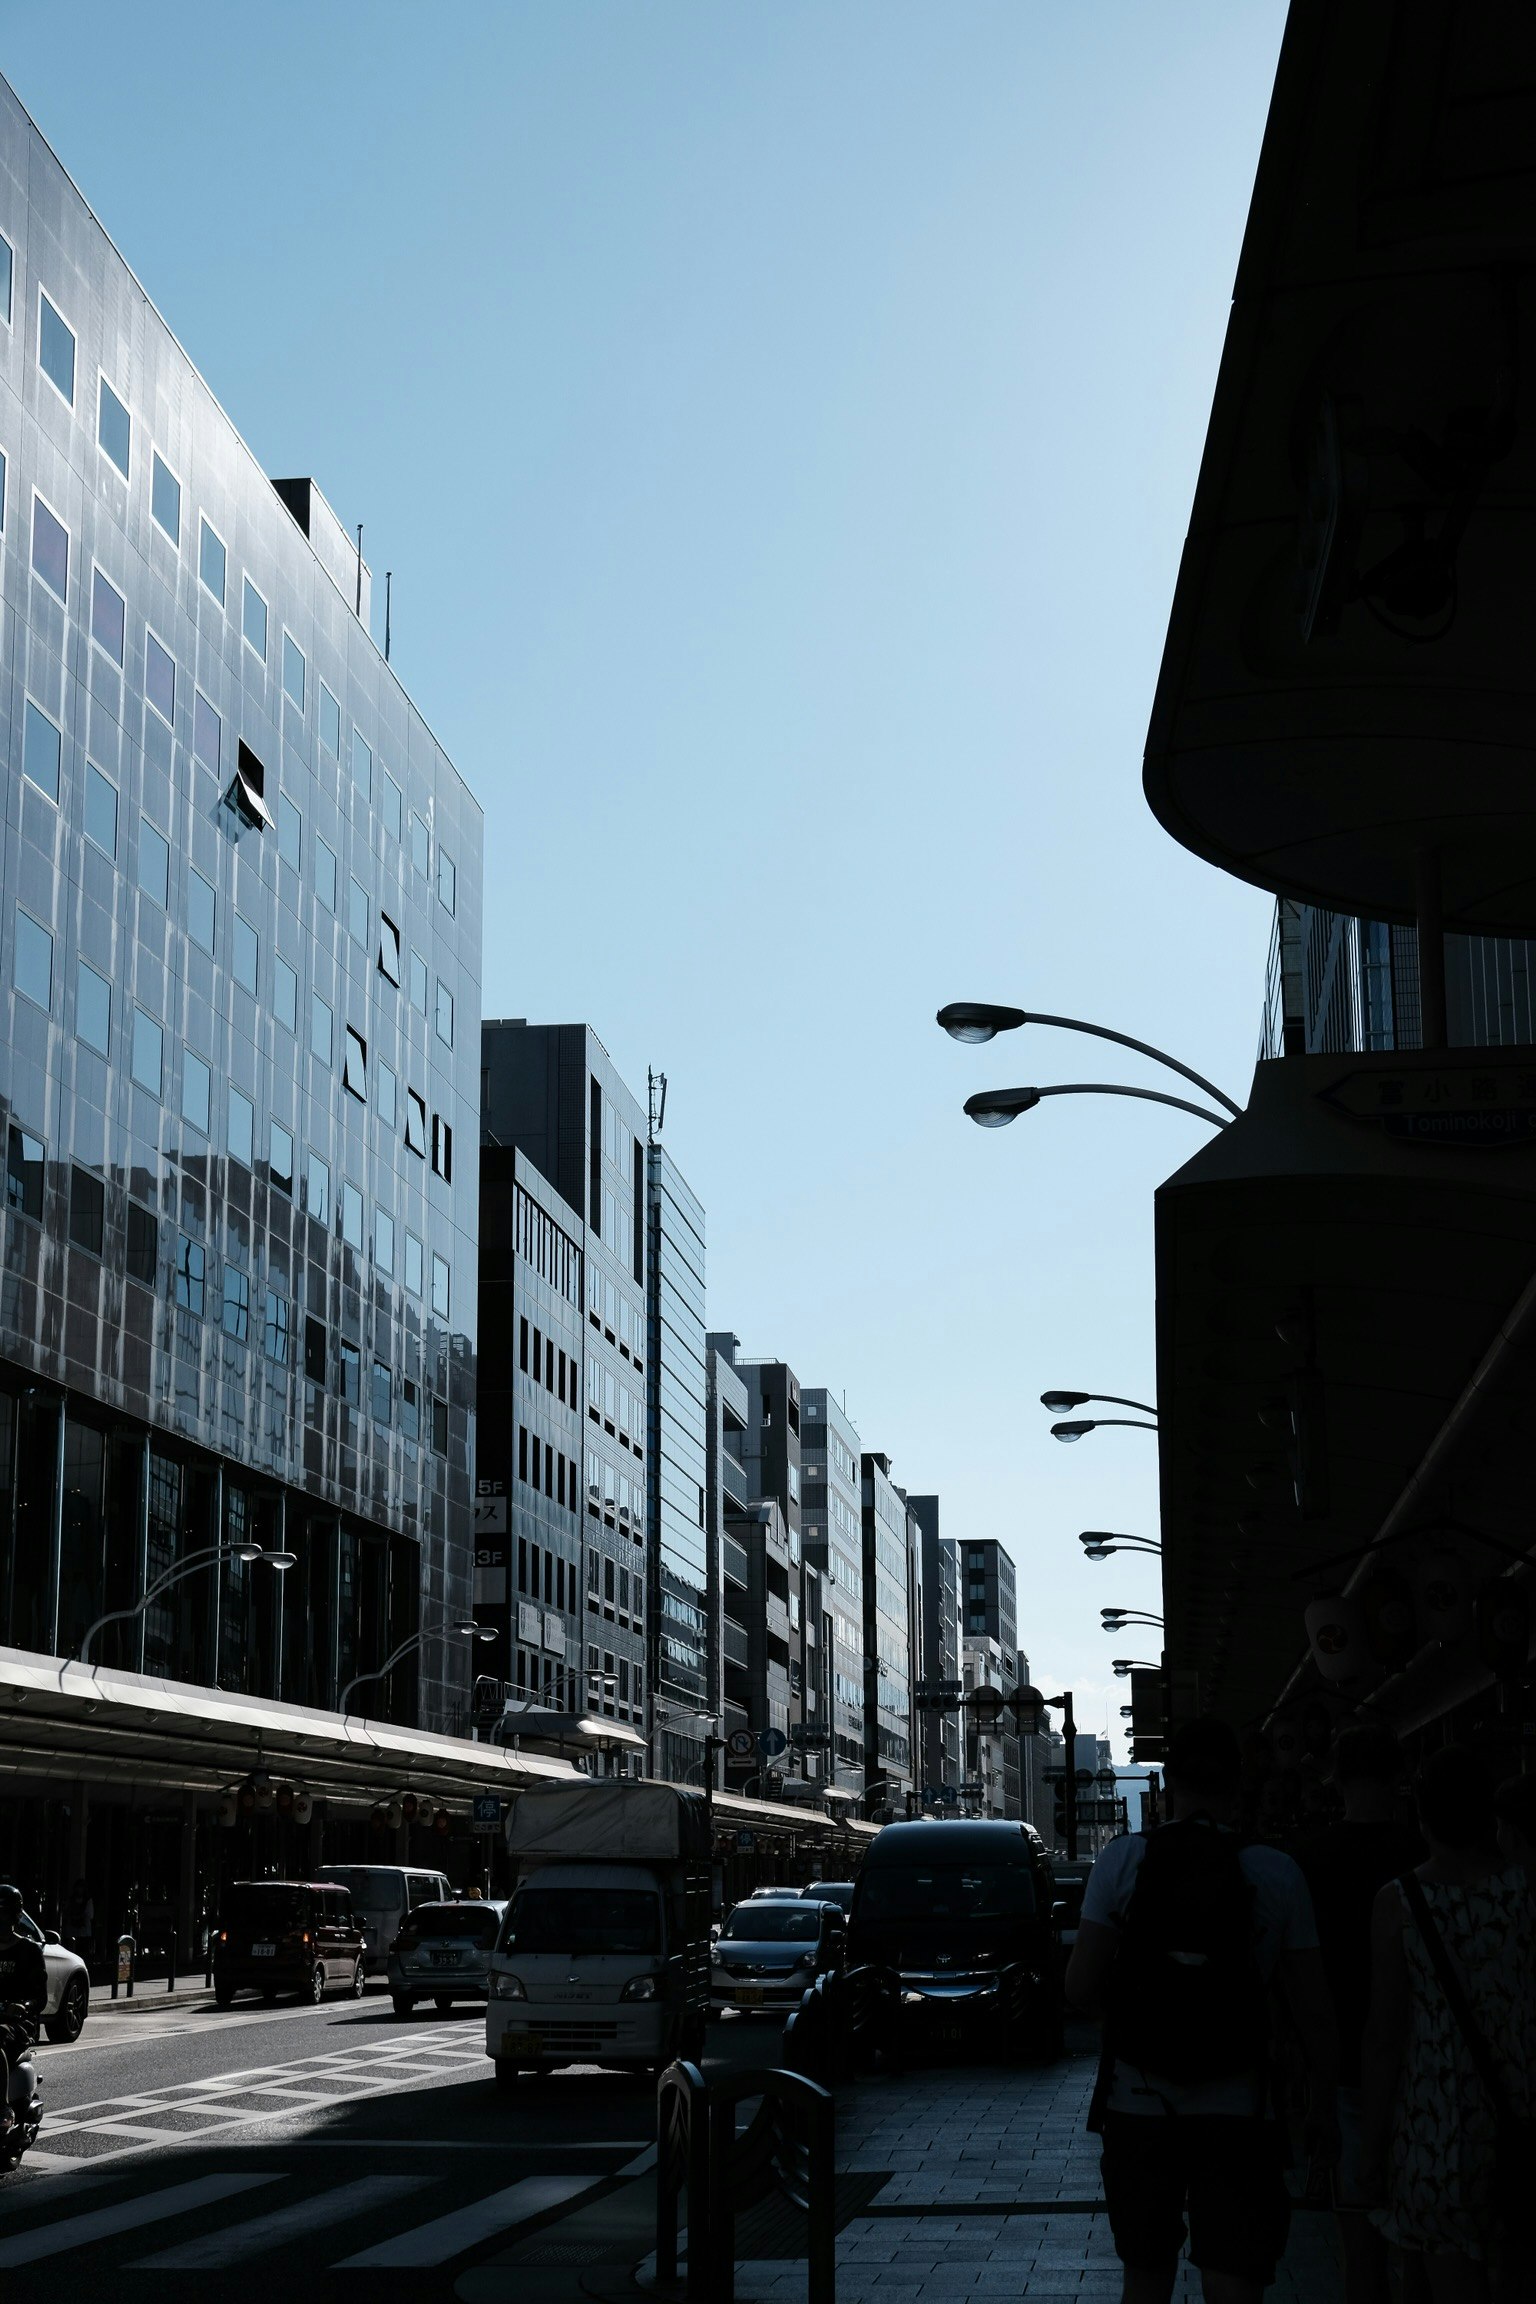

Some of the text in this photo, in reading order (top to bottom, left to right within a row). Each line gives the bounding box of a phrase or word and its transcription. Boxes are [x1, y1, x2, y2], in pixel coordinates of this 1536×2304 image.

[1405, 1110, 1517, 1134] Tominokoji
[478, 1479, 504, 1495] 5F
[477, 1549, 503, 1565] 3F
[477, 1799, 496, 1818] 停
